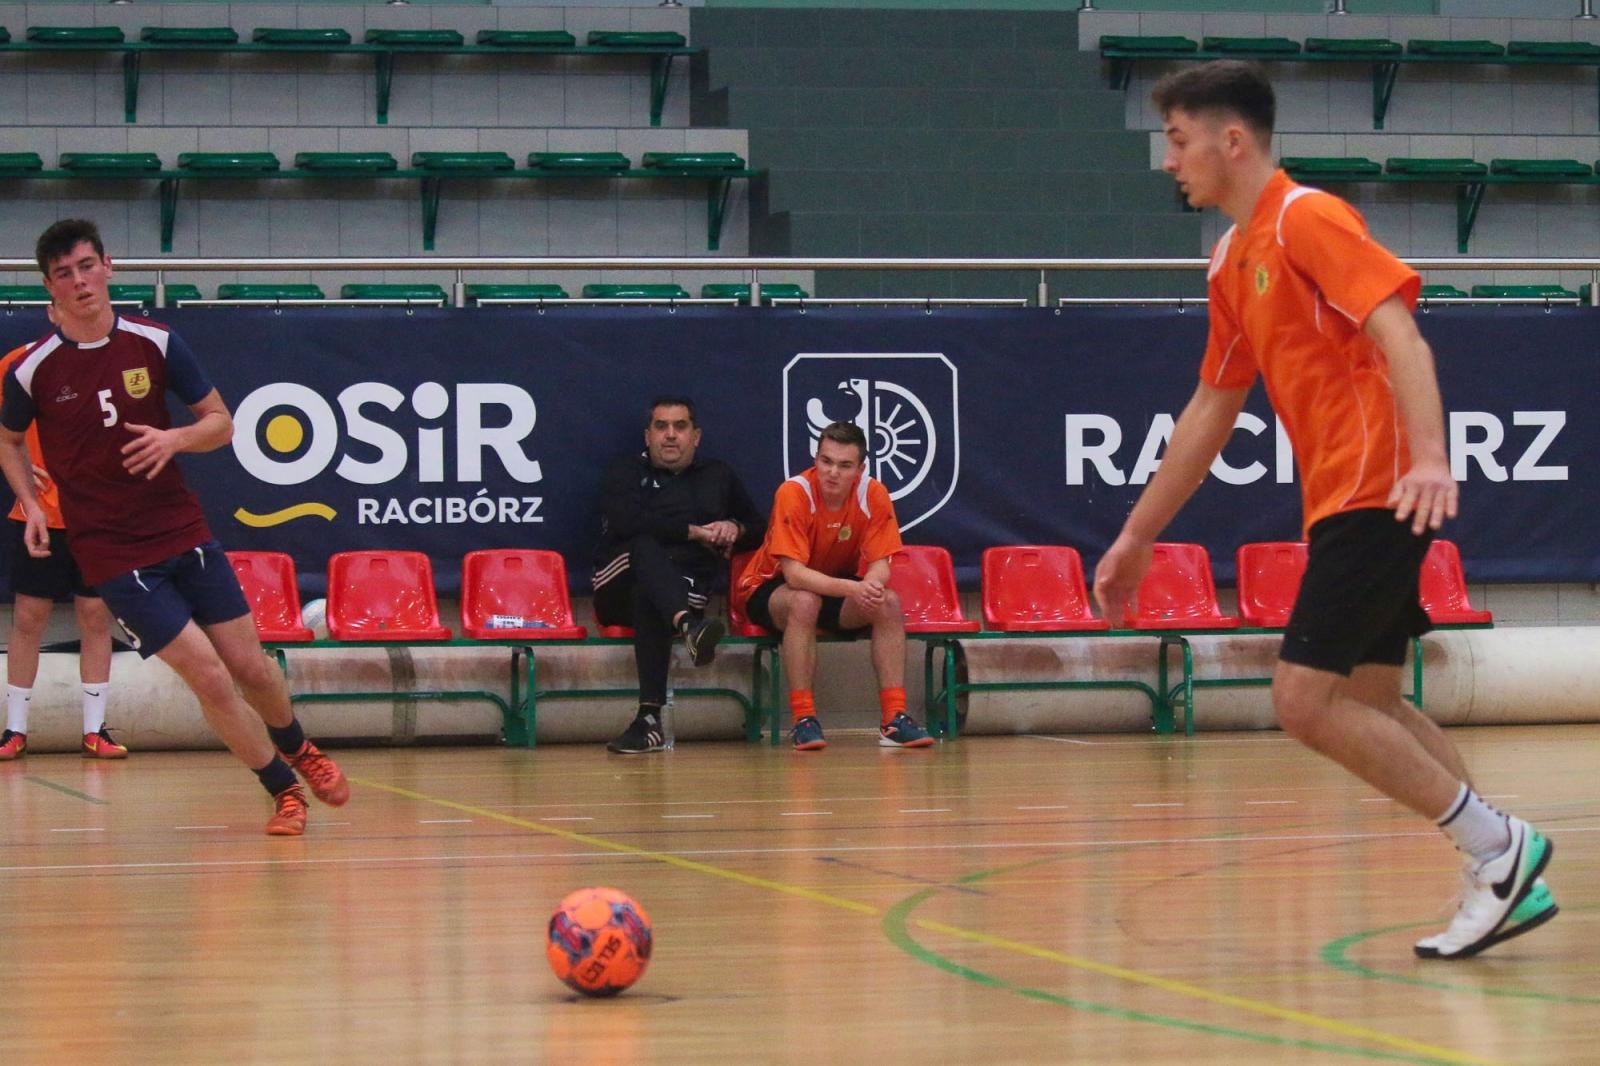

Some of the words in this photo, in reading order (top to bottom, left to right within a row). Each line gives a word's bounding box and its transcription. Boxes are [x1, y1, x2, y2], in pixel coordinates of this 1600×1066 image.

[98, 388, 118, 427] 5
[1065, 410, 1569, 485] RACIRZ
[357, 487, 544, 525] RACIBÓRZ
[583, 935, 622, 983] SELECT
